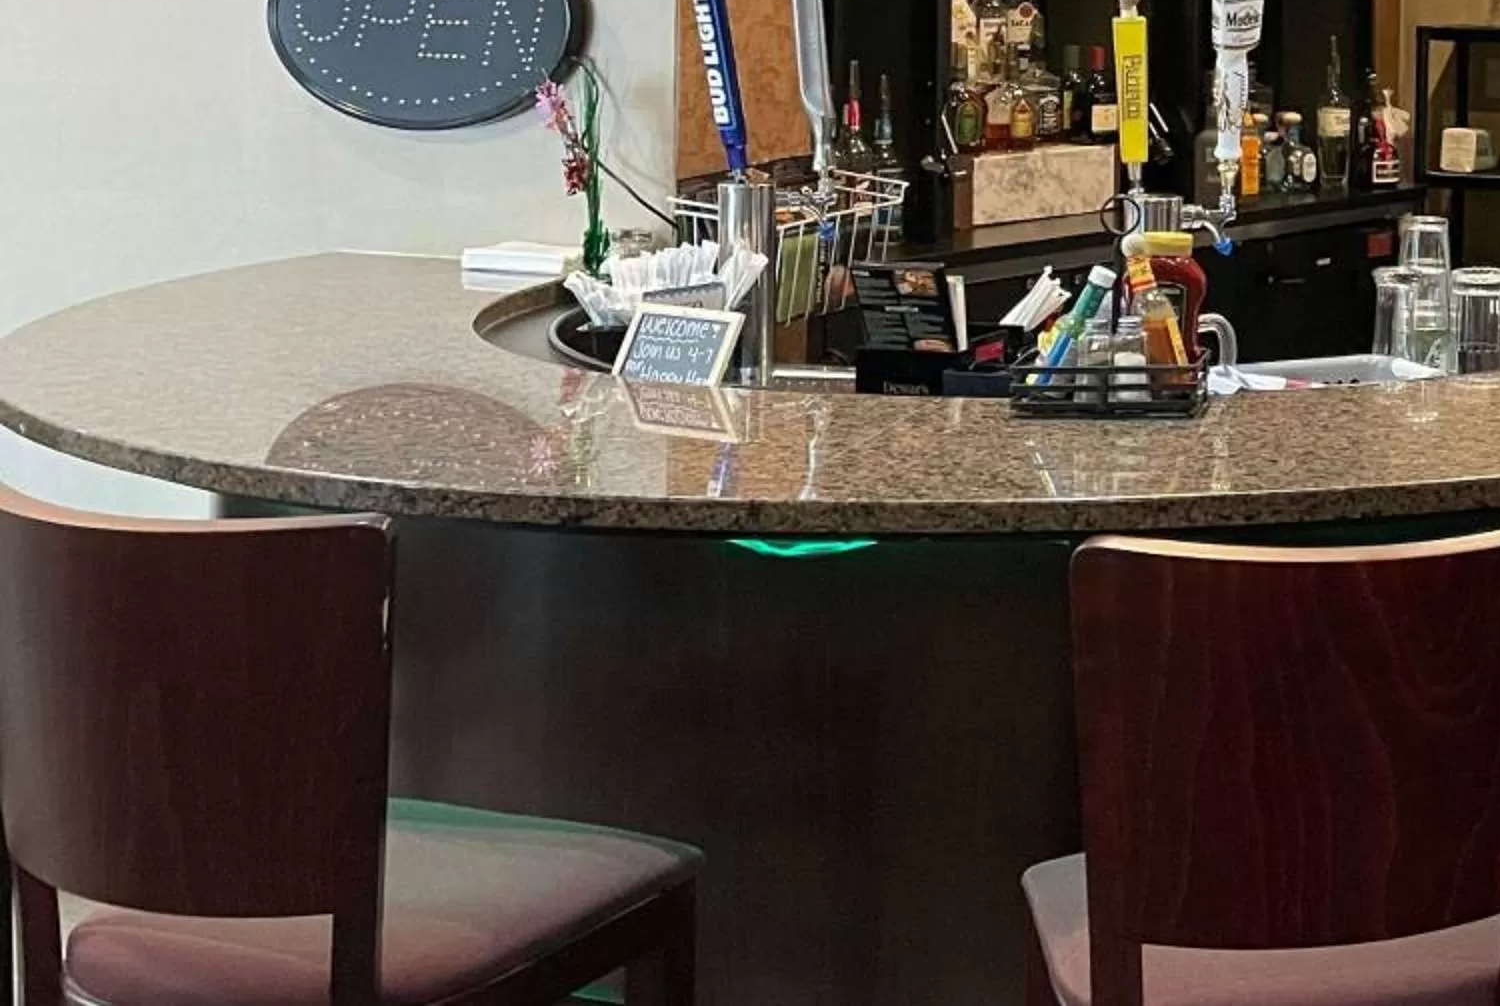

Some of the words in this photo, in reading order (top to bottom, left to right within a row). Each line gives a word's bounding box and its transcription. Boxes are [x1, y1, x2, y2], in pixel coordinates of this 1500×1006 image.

[707, 70, 731, 126] BUD
[633, 340, 663, 359] Join
[665, 345, 681, 360] us
